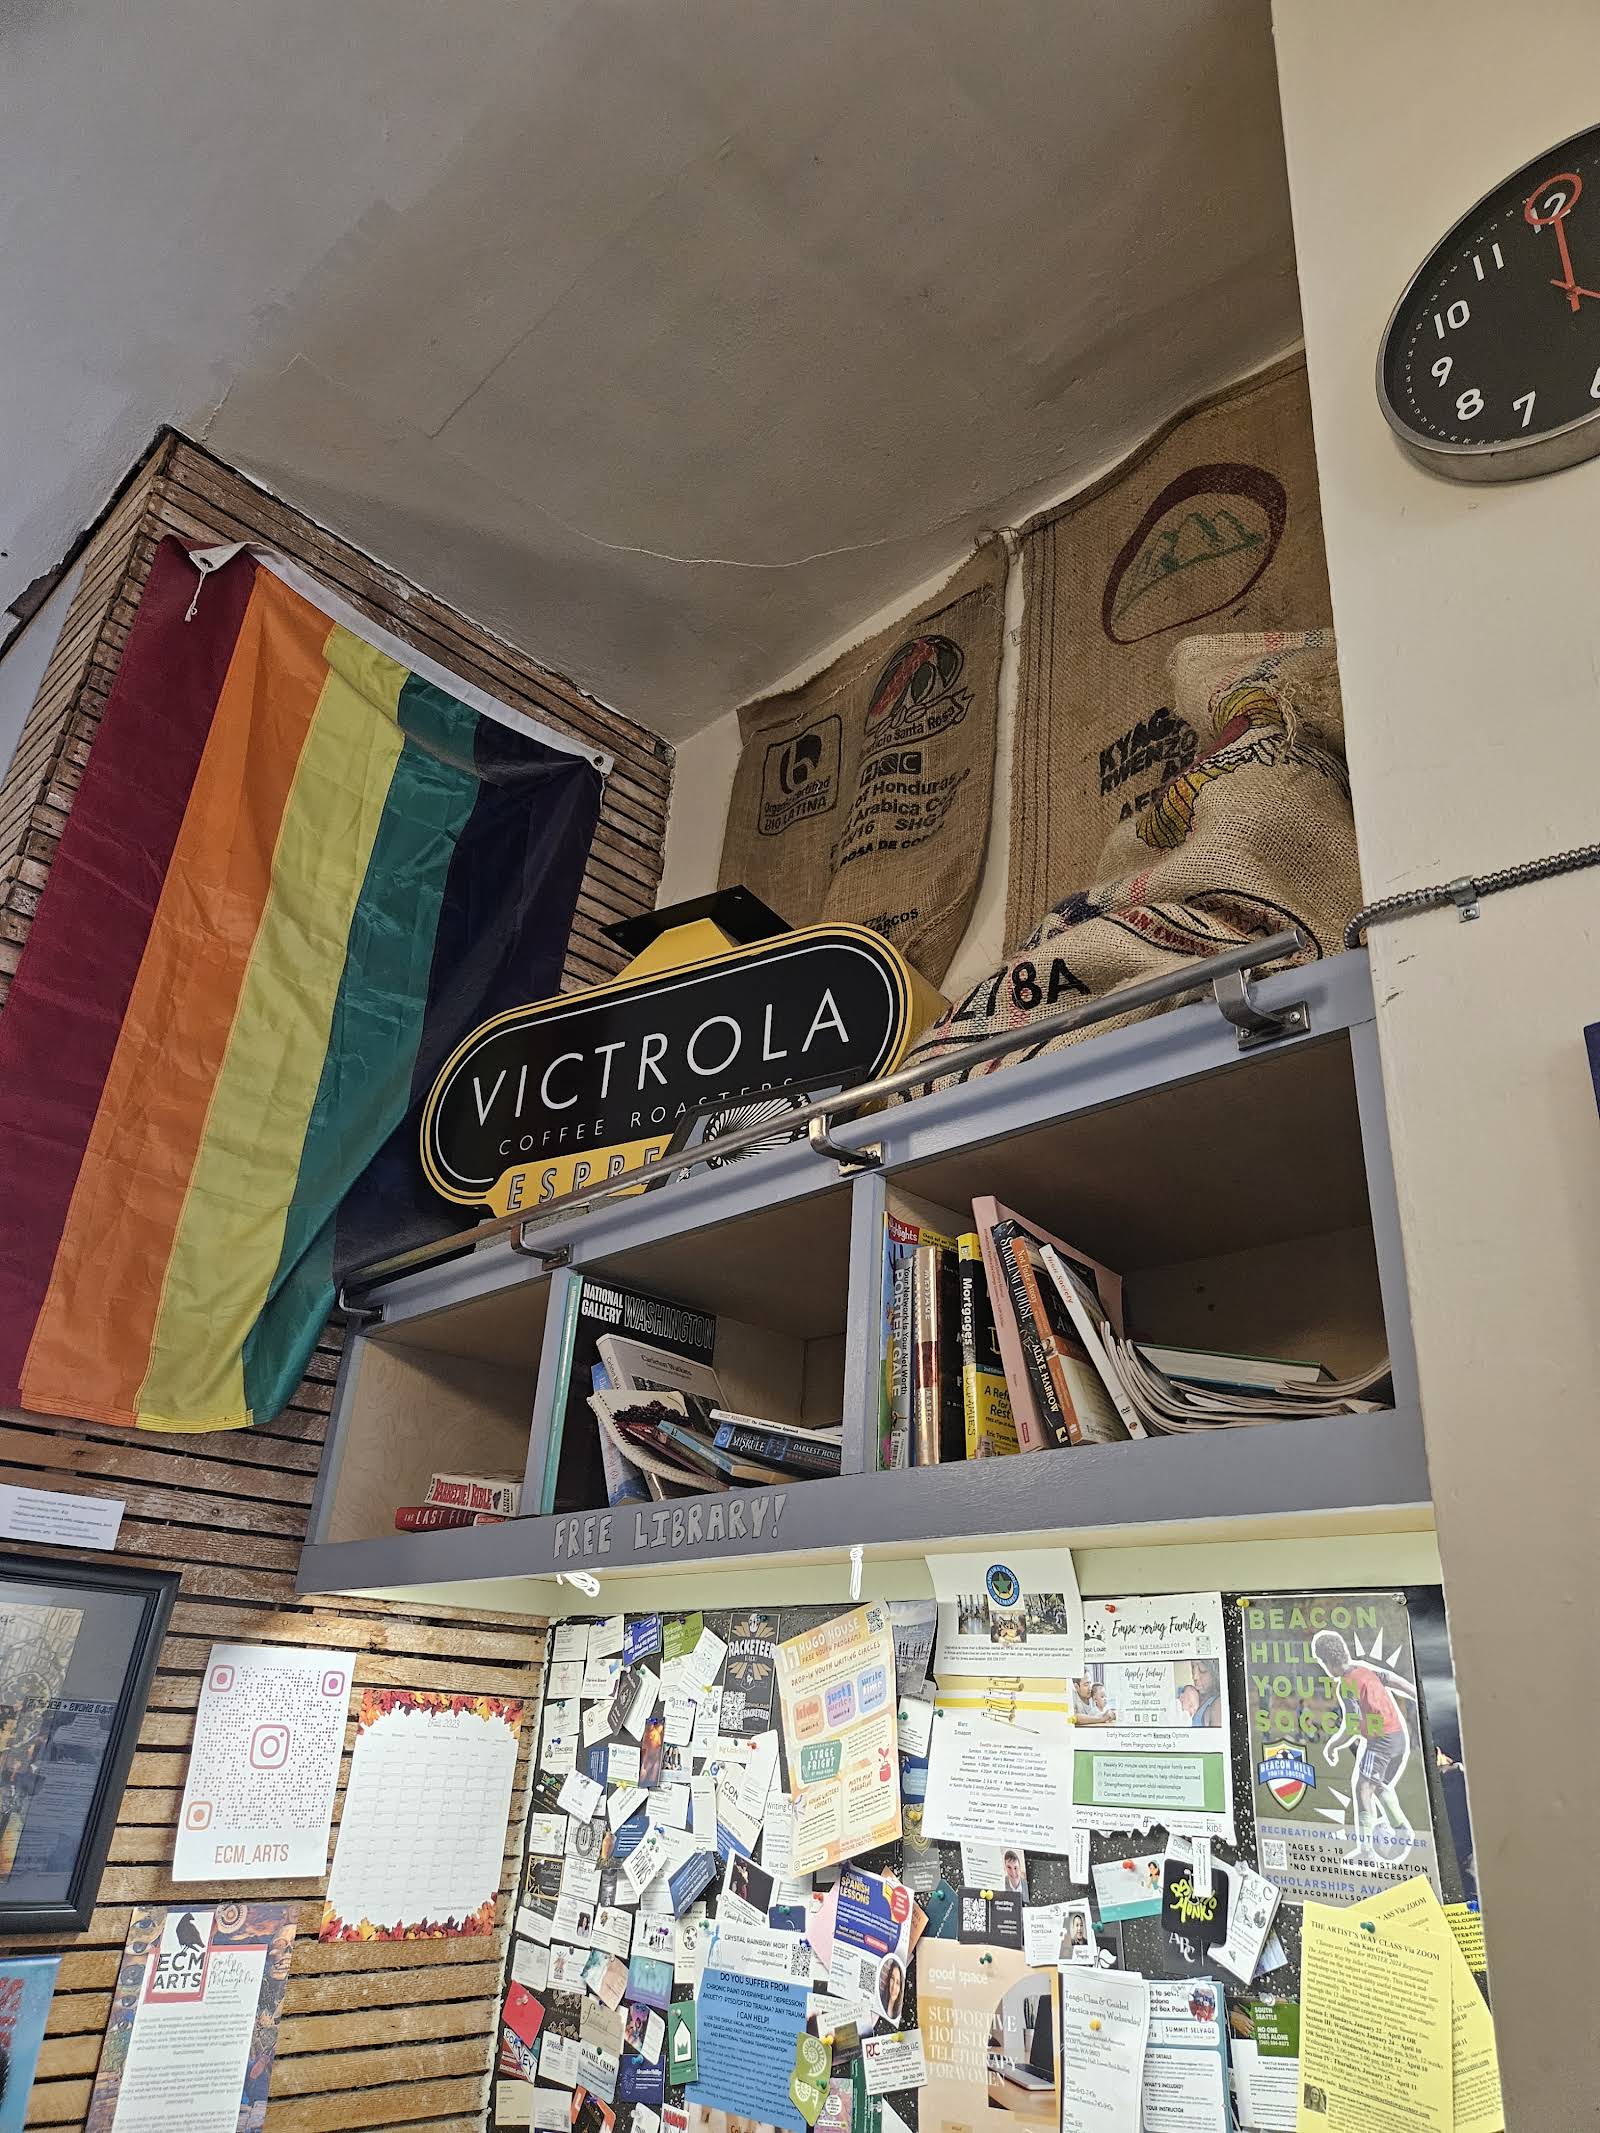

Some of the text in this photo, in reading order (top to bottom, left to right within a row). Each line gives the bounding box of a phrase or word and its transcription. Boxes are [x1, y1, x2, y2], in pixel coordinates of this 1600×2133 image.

[1472, 243, 1504, 281] 11
[1433, 300, 1470, 340] 10
[1431, 357, 1453, 387] 9
[1456, 388, 1484, 421] 8
[1512, 391, 1536, 427] 7
[877, 839, 897, 851] DE
[473, 987, 851, 1128] VICTROLA
[499, 1118, 606, 1157] COFFEE
[506, 1146, 663, 1212] ESPRE
[1000, 1237, 1022, 1286] STARLING
[903, 1266, 912, 1287] Your
[583, 1282, 624, 1309] NATIONAL
[902, 1288, 912, 1320] Network
[581, 1295, 715, 1350] GALLERY WASHINGTON
[961, 1277, 973, 1346] Mortgages
[892, 1268, 905, 1397] PORTER GALE
[901, 1331, 910, 1349] Your
[901, 1352, 909, 1368] Net
[900, 1368, 908, 1395] Worth
[1032, 1343, 1048, 1365] ALIX
[1041, 1373, 1060, 1414] HARROW
[984, 1385, 991, 1395] A
[990, 1405, 1011, 1419] Rest
[999, 1398, 1009, 1409] for
[732, 1435, 767, 1453] MISRULE
[793, 1443, 821, 1456] DARKEST
[469, 1483, 493, 1511] BIBLE
[415, 1510, 445, 1525] LAST
[553, 1494, 787, 1560] FREE LIBRARY!
[1169, 1612, 1208, 1634] Families
[1249, 1606, 1378, 1631] BEACON
[799, 1617, 862, 1656] HUGO HOUSE
[728, 1639, 777, 1660] RACKETEER
[1251, 1640, 1319, 1665] HILL
[1252, 1674, 1360, 1700] YOUTH
[1254, 1709, 1386, 1738] SOCCER
[807, 1757, 835, 1771] FRIGHT
[809, 1747, 834, 1761] STAGE
[1260, 1761, 1313, 1777] BEACON HILL
[1261, 1825, 1428, 1848] RECREATIONAL YOUTH SOCCER
[214, 1843, 289, 1867] ECM_ARTS
[1318, 1845, 1324, 1853] 5
[1334, 1847, 1344, 1855] 18
[1310, 1865, 1368, 1878] EXPERIENCE
[1320, 1856, 1355, 1867] ONLINE
[1357, 1859, 1429, 1873] REGISTRATION
[841, 1876, 870, 1896] SPANISH
[1266, 1875, 1355, 1893] SCHOLARSHIPS
[839, 1885, 870, 1906] LESSONS
[1406, 1897, 1427, 1911] ZOOM
[724, 1933, 746, 1944] CRYSTAL
[747, 1937, 772, 1948] RAINBOW
[1311, 1920, 1440, 1961] THE ARTIST'S WAY CLASS Via ZOOM
[157, 1951, 204, 1973] ECM
[151, 1972, 202, 1991] ARTS
[720, 1972, 790, 1994] DO YOU SUFFER FROM
[706, 1983, 726, 1993] CHRONIC
[773, 1995, 806, 2008] DEPRESSION?
[739, 2011, 752, 2021] CAN
[775, 2006, 785, 2015] ANY
[928, 2005, 1018, 2033] SUPPORTIVE
[1159, 2005, 1189, 2014] Box Pouch
[1254, 2006, 1273, 2014] SOUTH
[1255, 2013, 1278, 2021] SEATTLE
[929, 2025, 993, 2049] HOLISTIC
[1165, 2026, 1215, 2035] SUMMIT SELVAGE
[1270, 2033, 1289, 2041] ALONE
